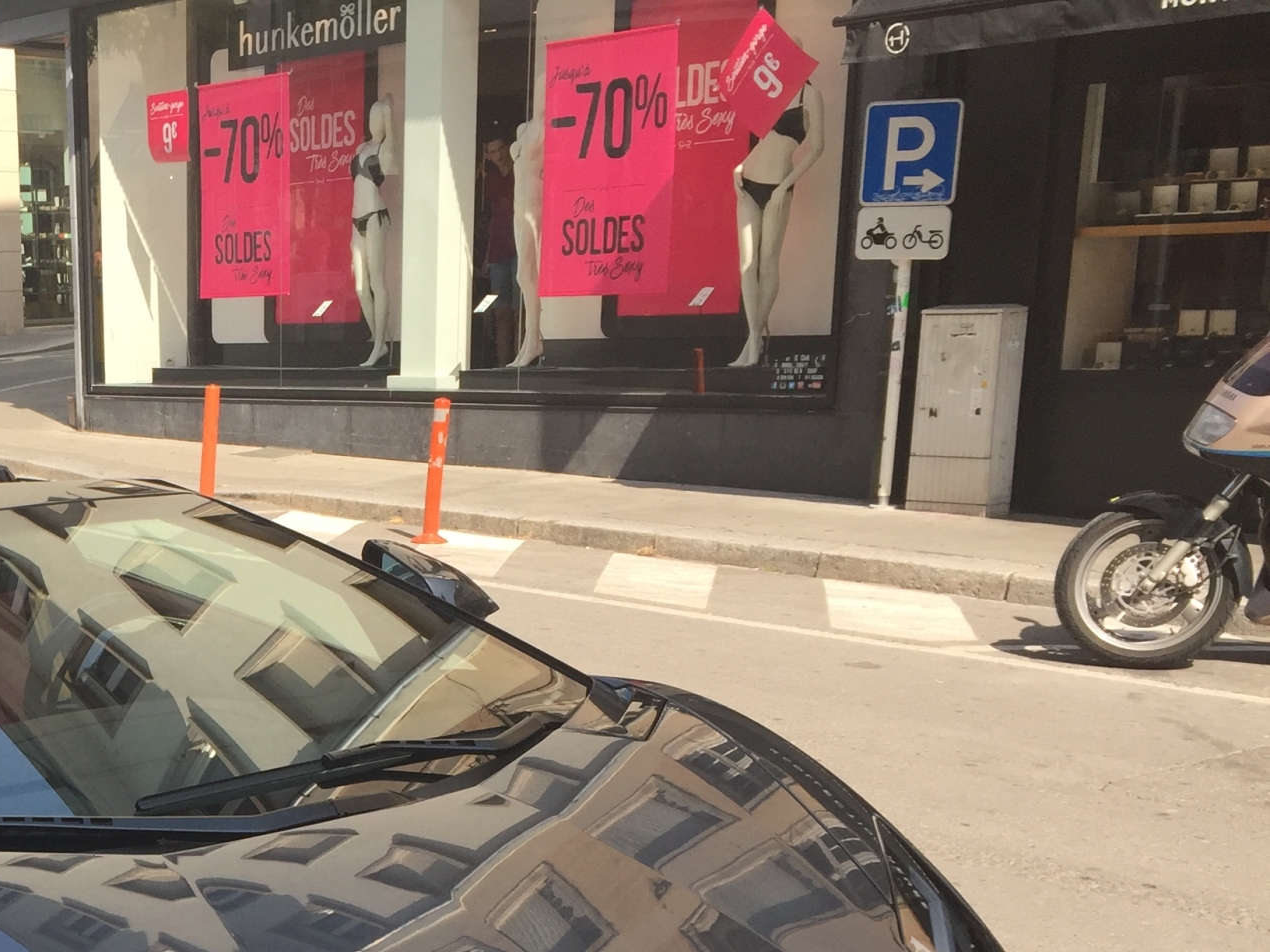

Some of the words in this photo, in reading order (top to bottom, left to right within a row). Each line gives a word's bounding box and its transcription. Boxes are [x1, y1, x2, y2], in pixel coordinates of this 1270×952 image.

[753, 51, 783, 98] 9€
[296, 95, 314, 116] Des
[551, 72, 668, 159] -70%
[696, 107, 736, 135] Sexy
[162, 121, 178, 154] 9€
[204, 112, 283, 184] -70%
[289, 109, 356, 153] SOLDES
[883, 116, 936, 191] P
[573, 196, 595, 218] Des
[214, 229, 272, 265] SOLDES
[561, 214, 645, 256] SOLDES
[609, 256, 644, 282] Sexy
